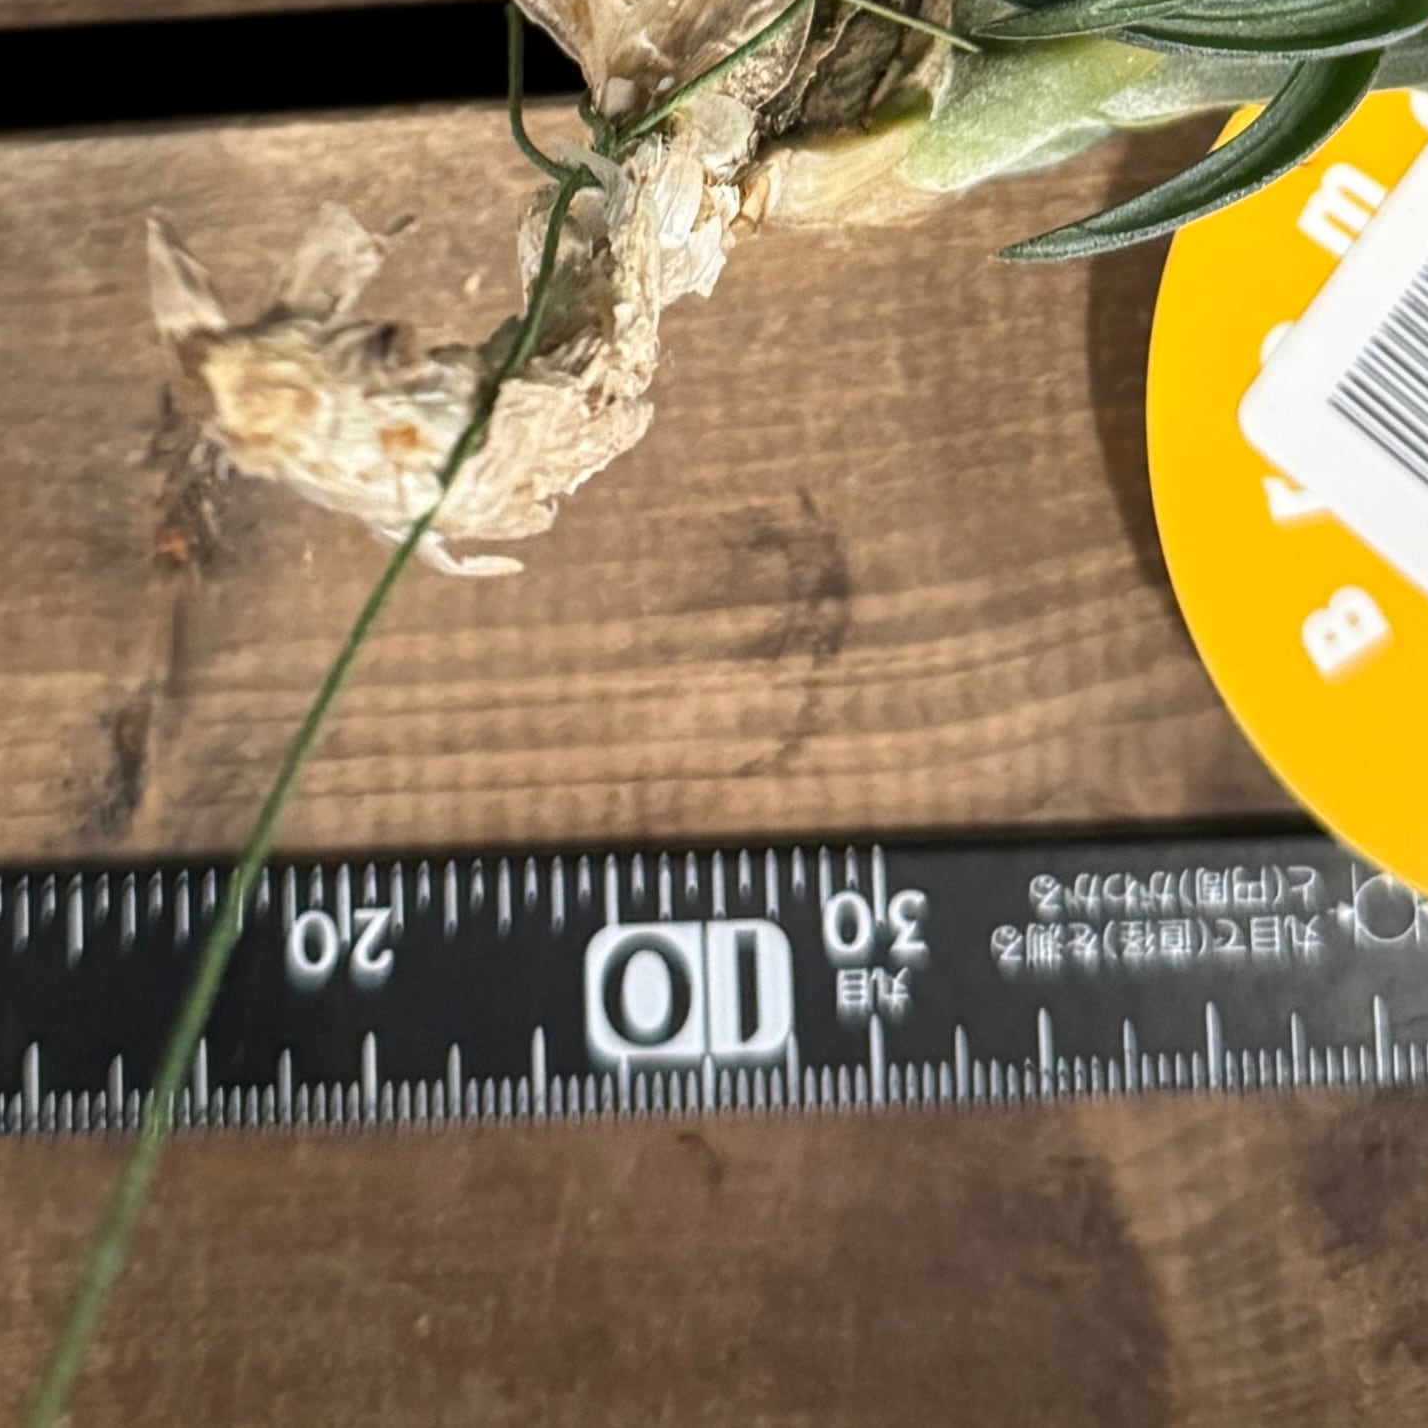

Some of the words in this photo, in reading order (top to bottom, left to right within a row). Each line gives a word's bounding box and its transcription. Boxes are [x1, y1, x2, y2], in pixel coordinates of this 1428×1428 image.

[289, 907, 396, 976] 20
[823, 889, 929, 954] 30
[602, 927, 762, 1049] 10
[835, 966, 912, 1010] 丸目
